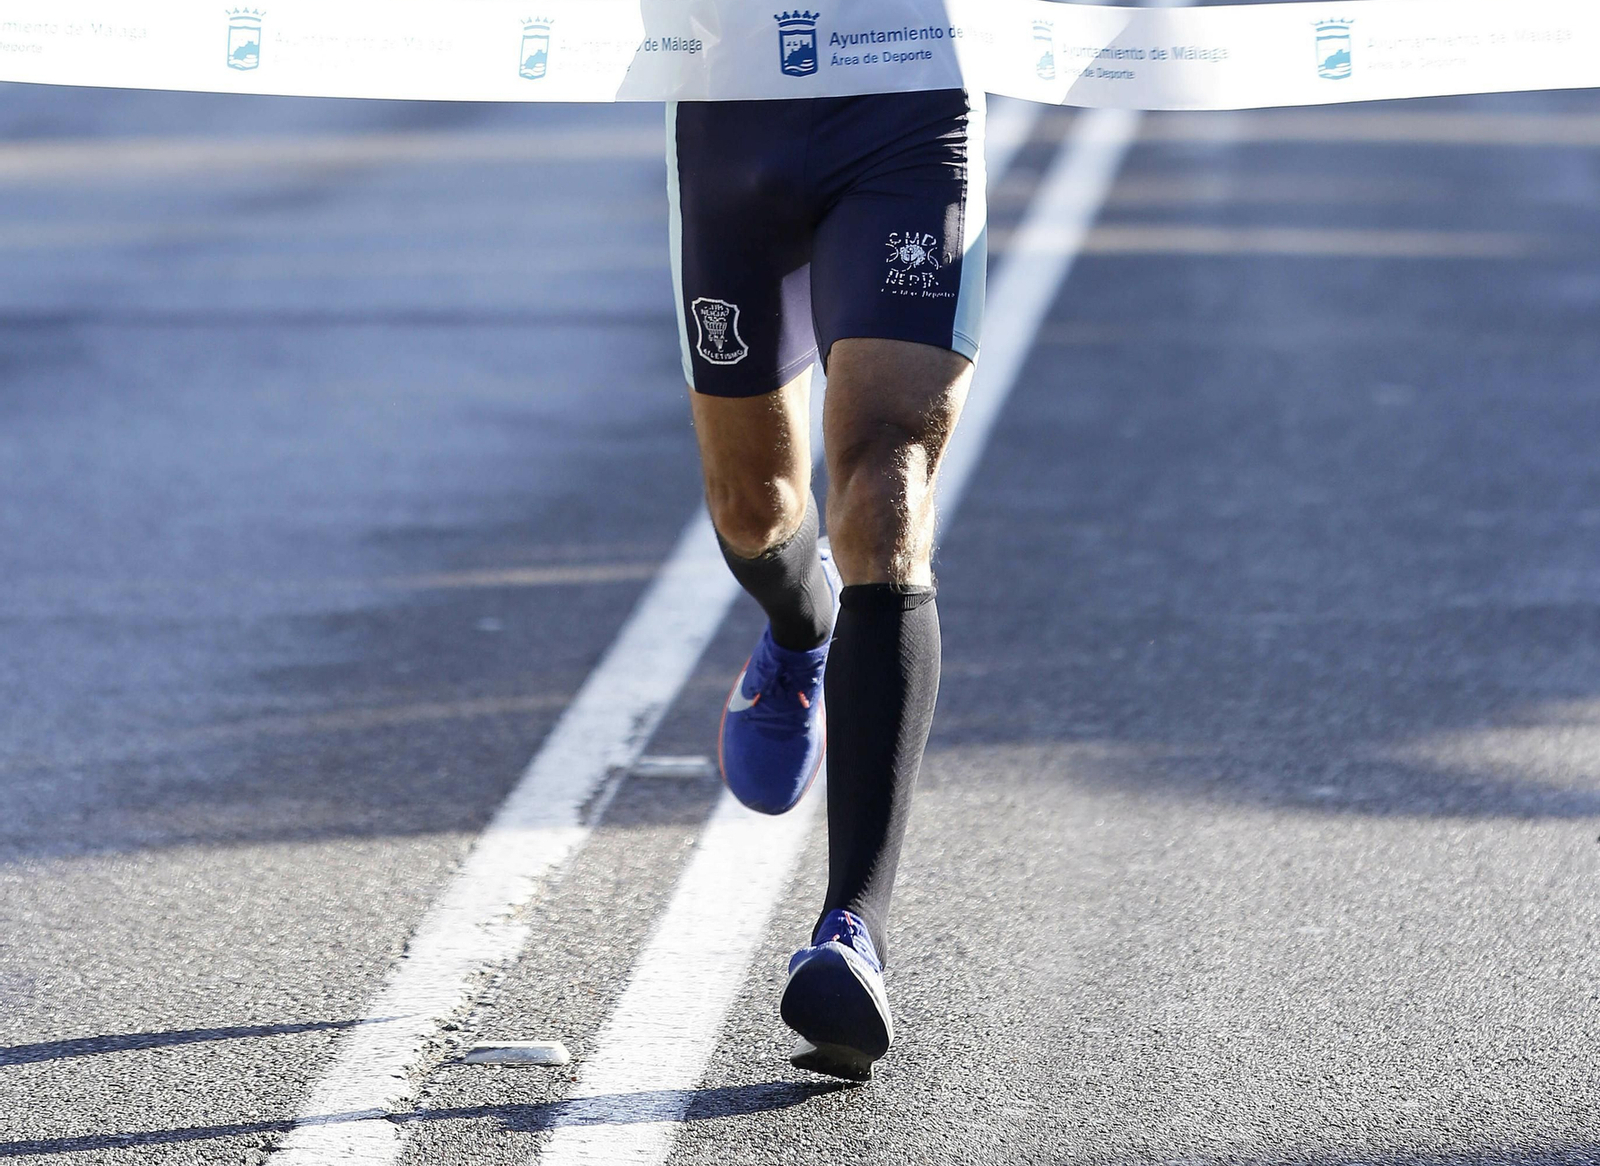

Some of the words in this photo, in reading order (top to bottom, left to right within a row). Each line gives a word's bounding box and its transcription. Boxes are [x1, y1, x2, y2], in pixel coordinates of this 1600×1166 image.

[644, 37, 658, 52] de
[661, 37, 703, 54] Málaga
[829, 26, 944, 49] Ayuntamiento
[948, 25, 963, 38] de
[830, 52, 859, 66] Área
[863, 52, 879, 65] de
[882, 49, 933, 65] Deporte
[1149, 46, 1169, 61] de
[1097, 67, 1135, 80] Deporte
